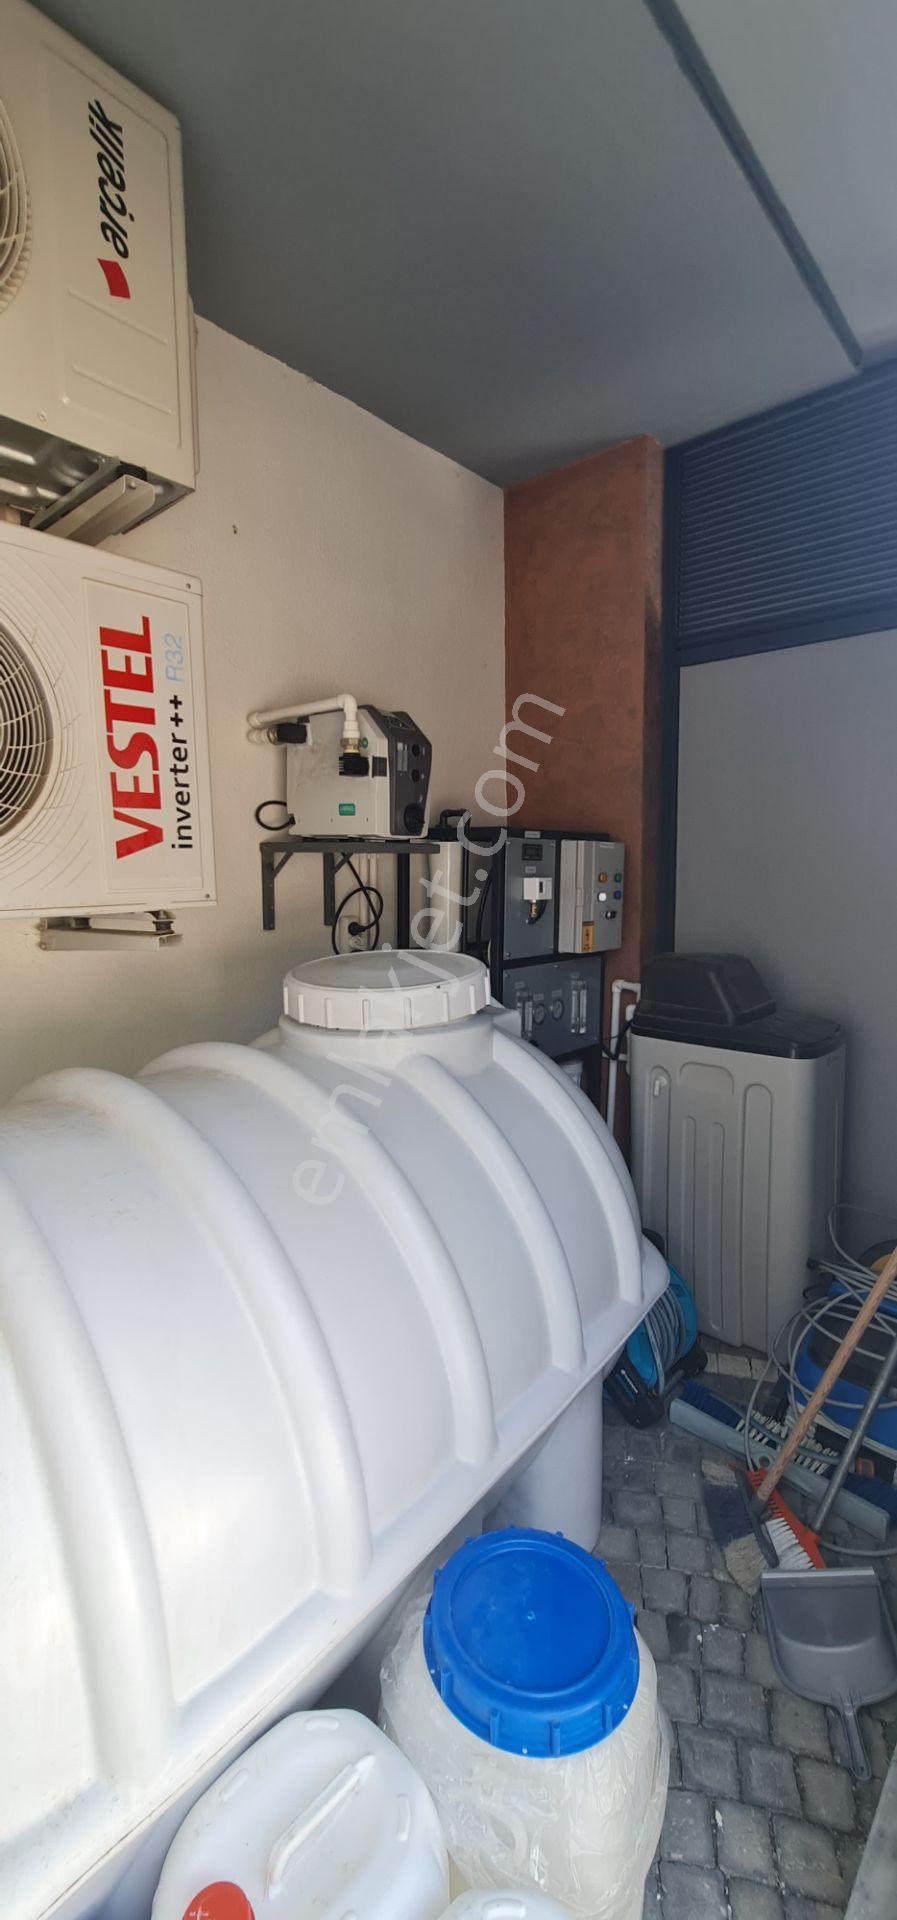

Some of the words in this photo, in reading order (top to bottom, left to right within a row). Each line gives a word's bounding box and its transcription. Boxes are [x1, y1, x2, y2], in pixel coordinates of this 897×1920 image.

[88, 100, 135, 259] arçelik
[99, 616, 163, 860] VESTEL
[164, 633, 184, 684] R32
